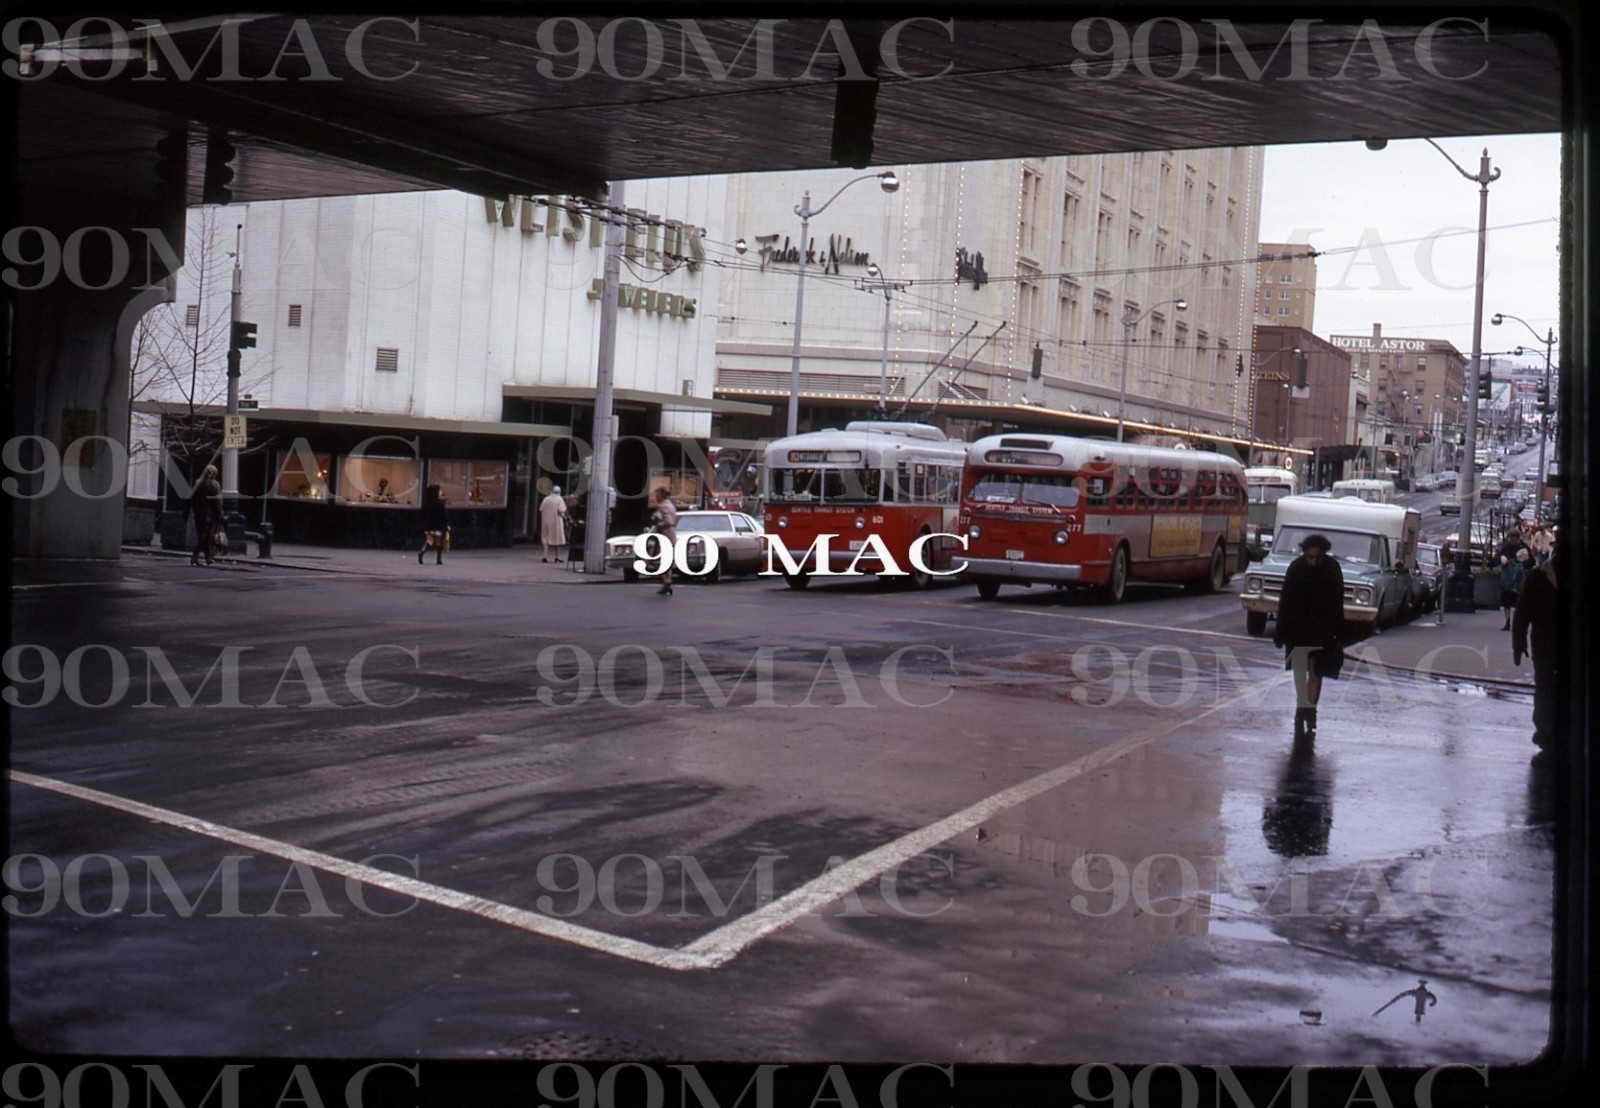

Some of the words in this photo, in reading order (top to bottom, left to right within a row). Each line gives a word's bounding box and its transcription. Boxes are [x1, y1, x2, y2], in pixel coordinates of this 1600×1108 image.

[825, 233, 869, 275] Nelson
[587, 278, 697, 319] JWELERS
[1332, 337, 1375, 348] HOTEL
[1380, 339, 1425, 350] ASTOR
[231, 416, 240, 425] DO
[230, 426, 241, 435] NOT
[227, 436, 245, 445] ENTER
[1067, 524, 1081, 532] 277
